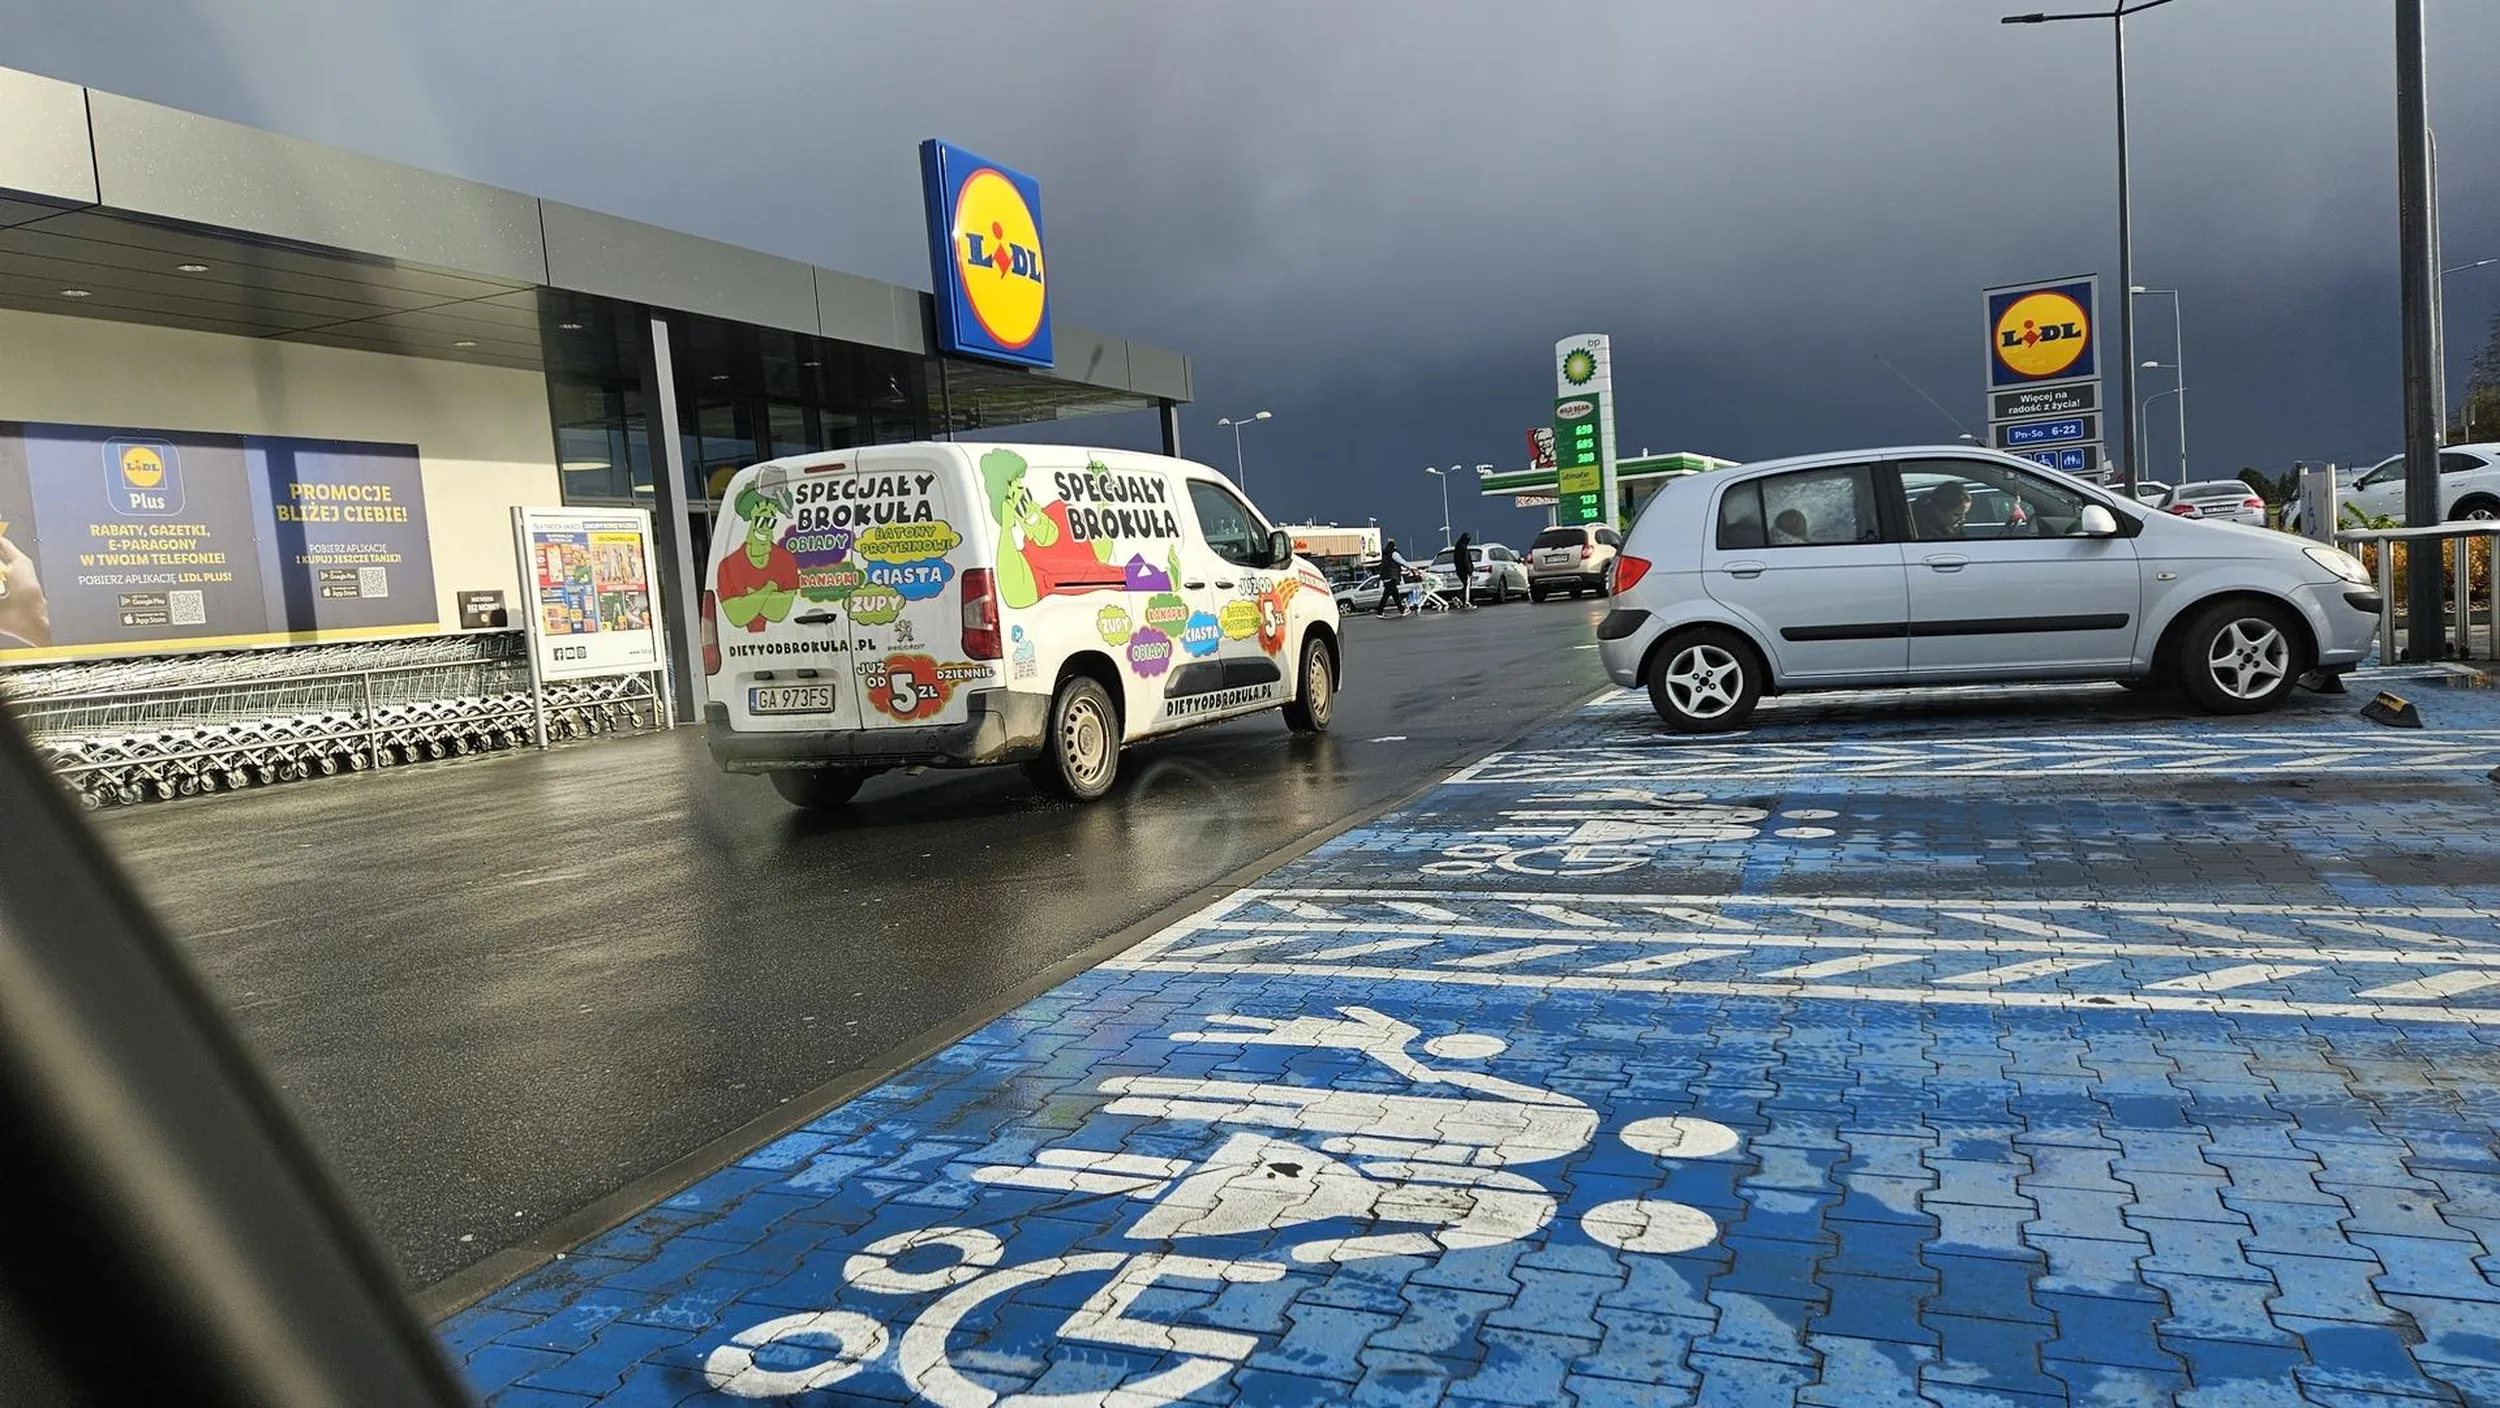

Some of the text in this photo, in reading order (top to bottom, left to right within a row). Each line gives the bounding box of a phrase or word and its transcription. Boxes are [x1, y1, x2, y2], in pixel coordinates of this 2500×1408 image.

[966, 221, 1042, 284] LIDL
[2001, 319, 2082, 348] LIDL
[1588, 339, 1601, 348] bp
[2020, 391, 2068, 403] Więcej na
[2008, 403, 2042, 414] radość
[2051, 398, 2080, 410] życia!
[2014, 424, 2076, 439] Pn-So 6-22
[126, 459, 160, 472] LIDL
[289, 483, 392, 501] PROMOCJE
[795, 474, 935, 504] SPECJAŁY
[1054, 471, 1165, 503] SPECJAŁY
[129, 492, 166, 509] Plus
[276, 502, 408, 522] BLIŻEJ CIEBIE!
[797, 500, 933, 531] BROKUŁA
[89, 524, 211, 538] RABATY, GAZETKI,
[1067, 508, 1180, 540] BROKUŁA
[787, 533, 848, 551] OBIADY
[875, 526, 937, 541] BATONY
[108, 538, 197, 551] E-PARAGONY
[309, 543, 387, 554] POBIERZ APLIKACJĘ
[79, 552, 226, 566] W TWOIM TELEFONIE!
[301, 555, 333, 564] KUPUJ
[333, 554, 370, 563] JESZCZE
[370, 553, 402, 563] TANIEJ!
[78, 572, 232, 585] POBIERZ APLIKACJĘ LIDL PLUS!
[800, 572, 859, 587] KANAPKI
[871, 567, 942, 585] CIASTA
[850, 595, 902, 612] ZUPY
[1102, 617, 1130, 633] ZUPY
[1264, 601, 1276, 637] 5
[1185, 625, 1219, 642] CIASTA
[1132, 642, 1170, 660] OBIADY
[857, 658, 886, 675] JUŻ
[936, 667, 995, 680] DZIENNIE
[759, 688, 829, 708] GA 973FS
[867, 673, 939, 713] OD 5 ZŁ
